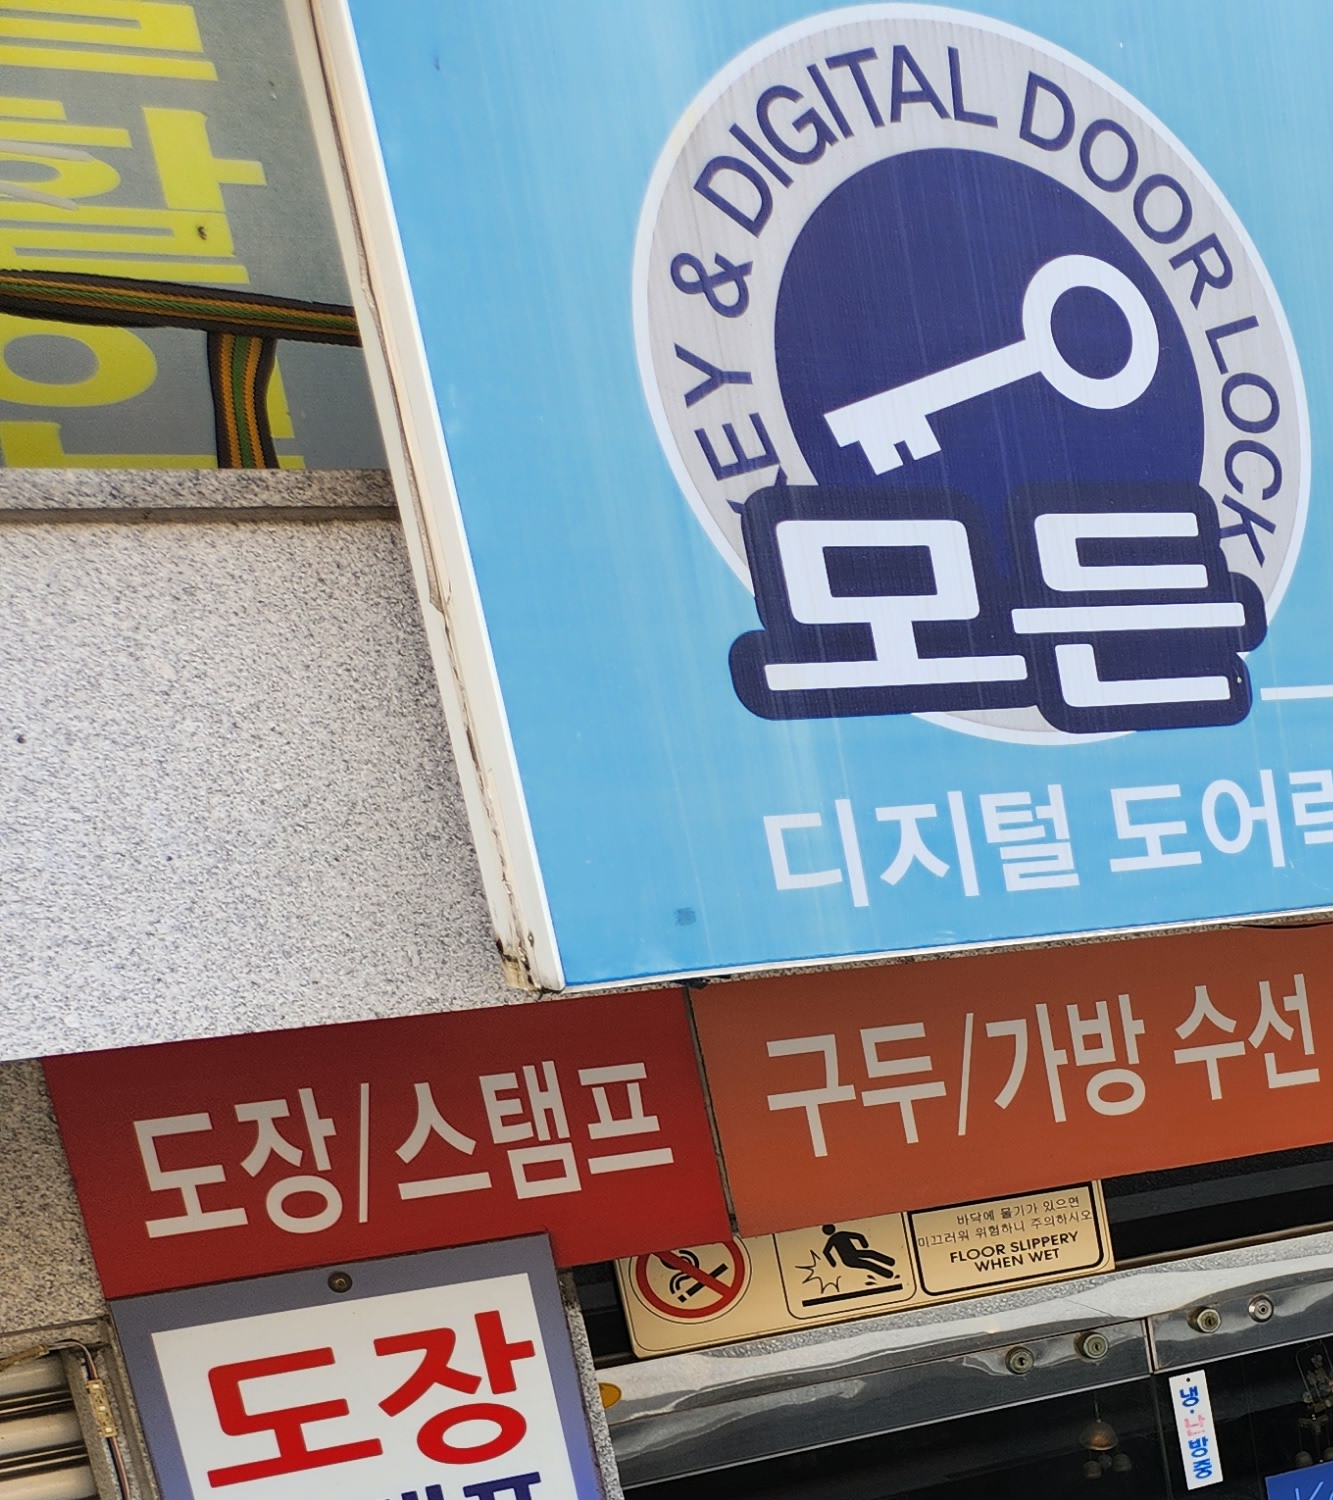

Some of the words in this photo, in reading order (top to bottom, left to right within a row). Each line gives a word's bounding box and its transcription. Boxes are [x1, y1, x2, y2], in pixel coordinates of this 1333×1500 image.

[693, 44, 998, 236] DIGITAL
[1019, 70, 1236, 309] DOOR
[672, 251, 753, 319] &
[1206, 314, 1284, 567] LOCK
[764, 511, 1246, 708] 모든
[764, 783, 1080, 908] 디지털
[133, 1060, 675, 1239] 도장/스탬프
[766, 993, 1147, 1158] 구두/가방
[1174, 973, 1321, 1101] 수선
[918, 1230, 970, 1248] 미끄러워
[975, 1221, 1025, 1239] 위험하니
[1031, 1209, 1093, 1230] 주의하시오
[949, 1243, 1006, 1263] FLOOR
[1010, 1231, 1079, 1253] SLIPPERY
[956, 1209, 995, 1226] 바닥에
[1043, 1196, 1080, 1213] 있으면
[974, 1254, 1024, 1273] WHEN
[1029, 1247, 1060, 1264] WET
[207, 1310, 536, 1488] 도장
